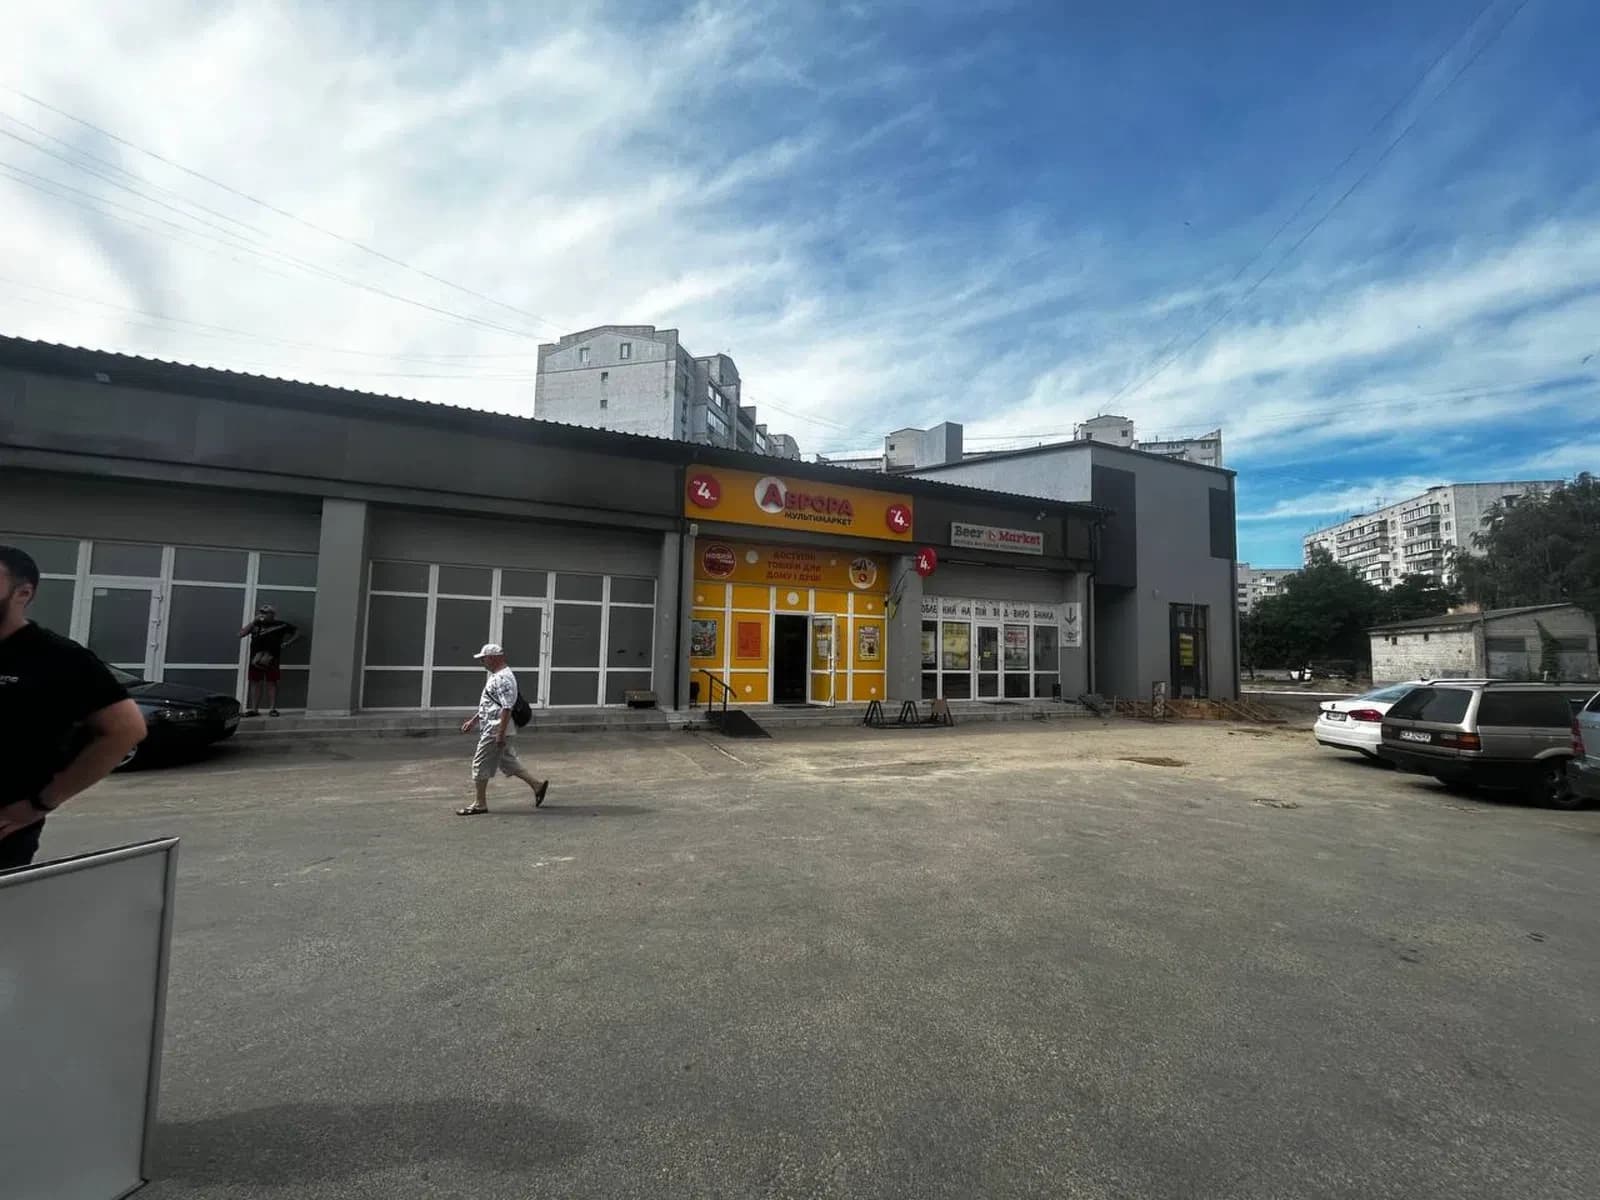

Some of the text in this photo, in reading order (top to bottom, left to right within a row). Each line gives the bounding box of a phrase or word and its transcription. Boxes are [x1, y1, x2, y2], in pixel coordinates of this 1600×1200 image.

[784, 511, 852, 526] МУЛЬТИМАРКЕТ
[954, 525, 984, 538] Beer
[999, 530, 1041, 546] Market
